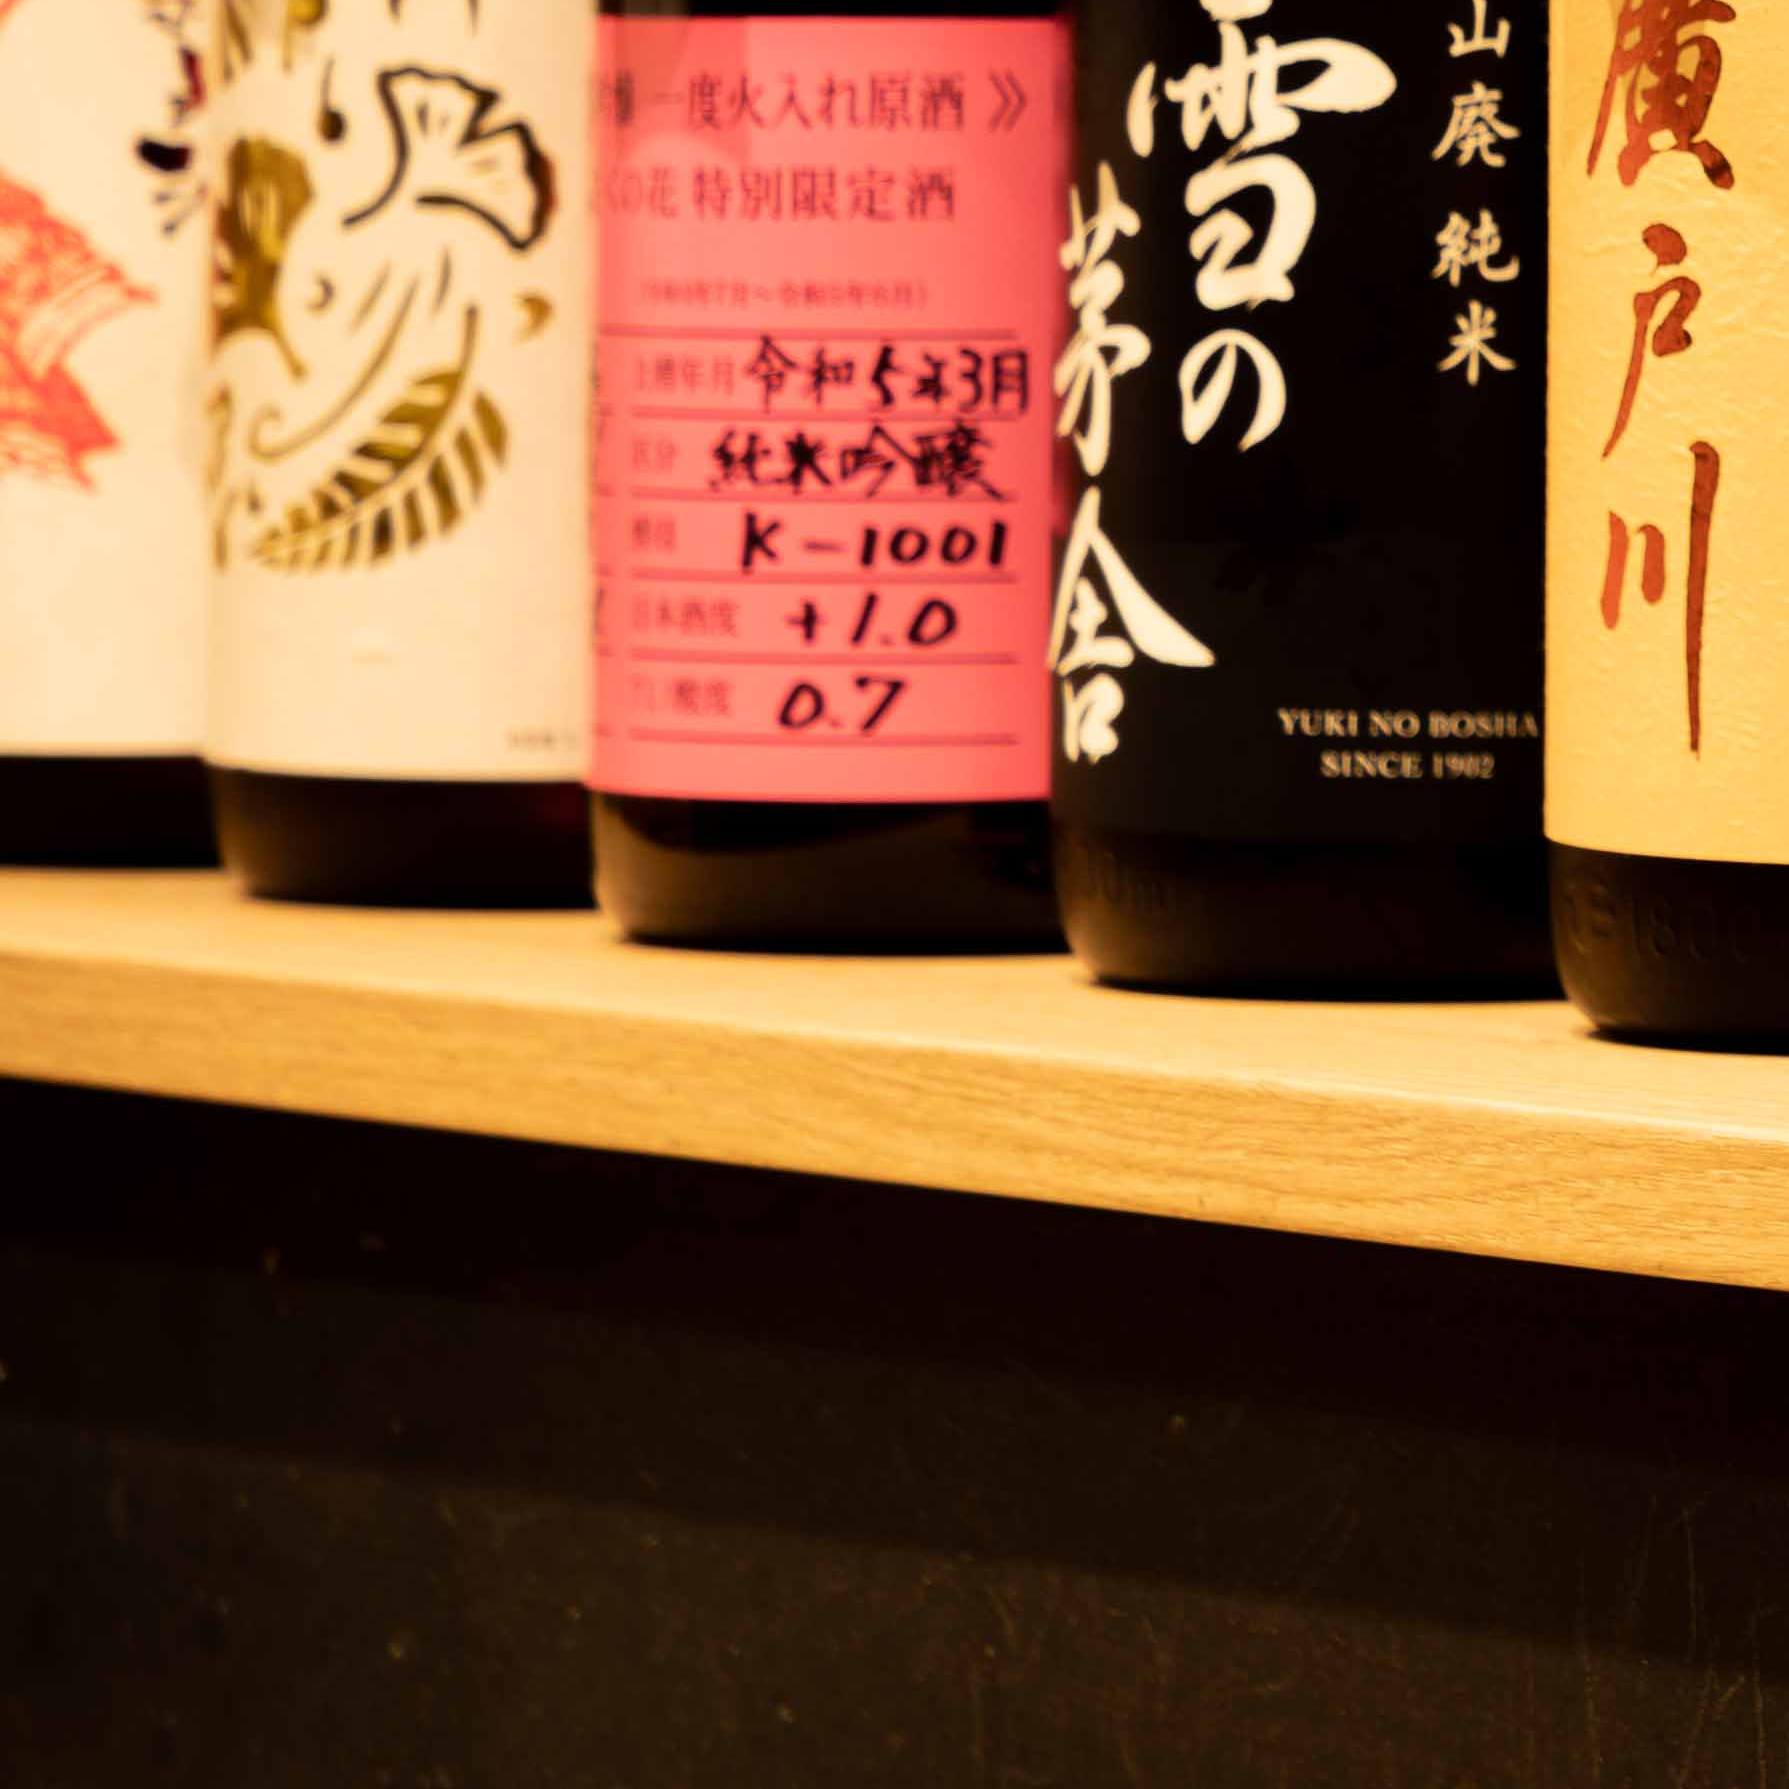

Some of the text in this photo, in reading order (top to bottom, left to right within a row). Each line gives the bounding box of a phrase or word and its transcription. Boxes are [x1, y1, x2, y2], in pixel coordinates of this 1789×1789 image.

[691, 162, 957, 221] 特別限定酒
[710, 420, 1004, 499] 純米吟醸
[787, 593, 958, 645] +1.0
[779, 676, 905, 735] 0.7
[1278, 707, 1539, 739] YUKI NO BOSHA
[1320, 750, 1423, 779] SINCE
